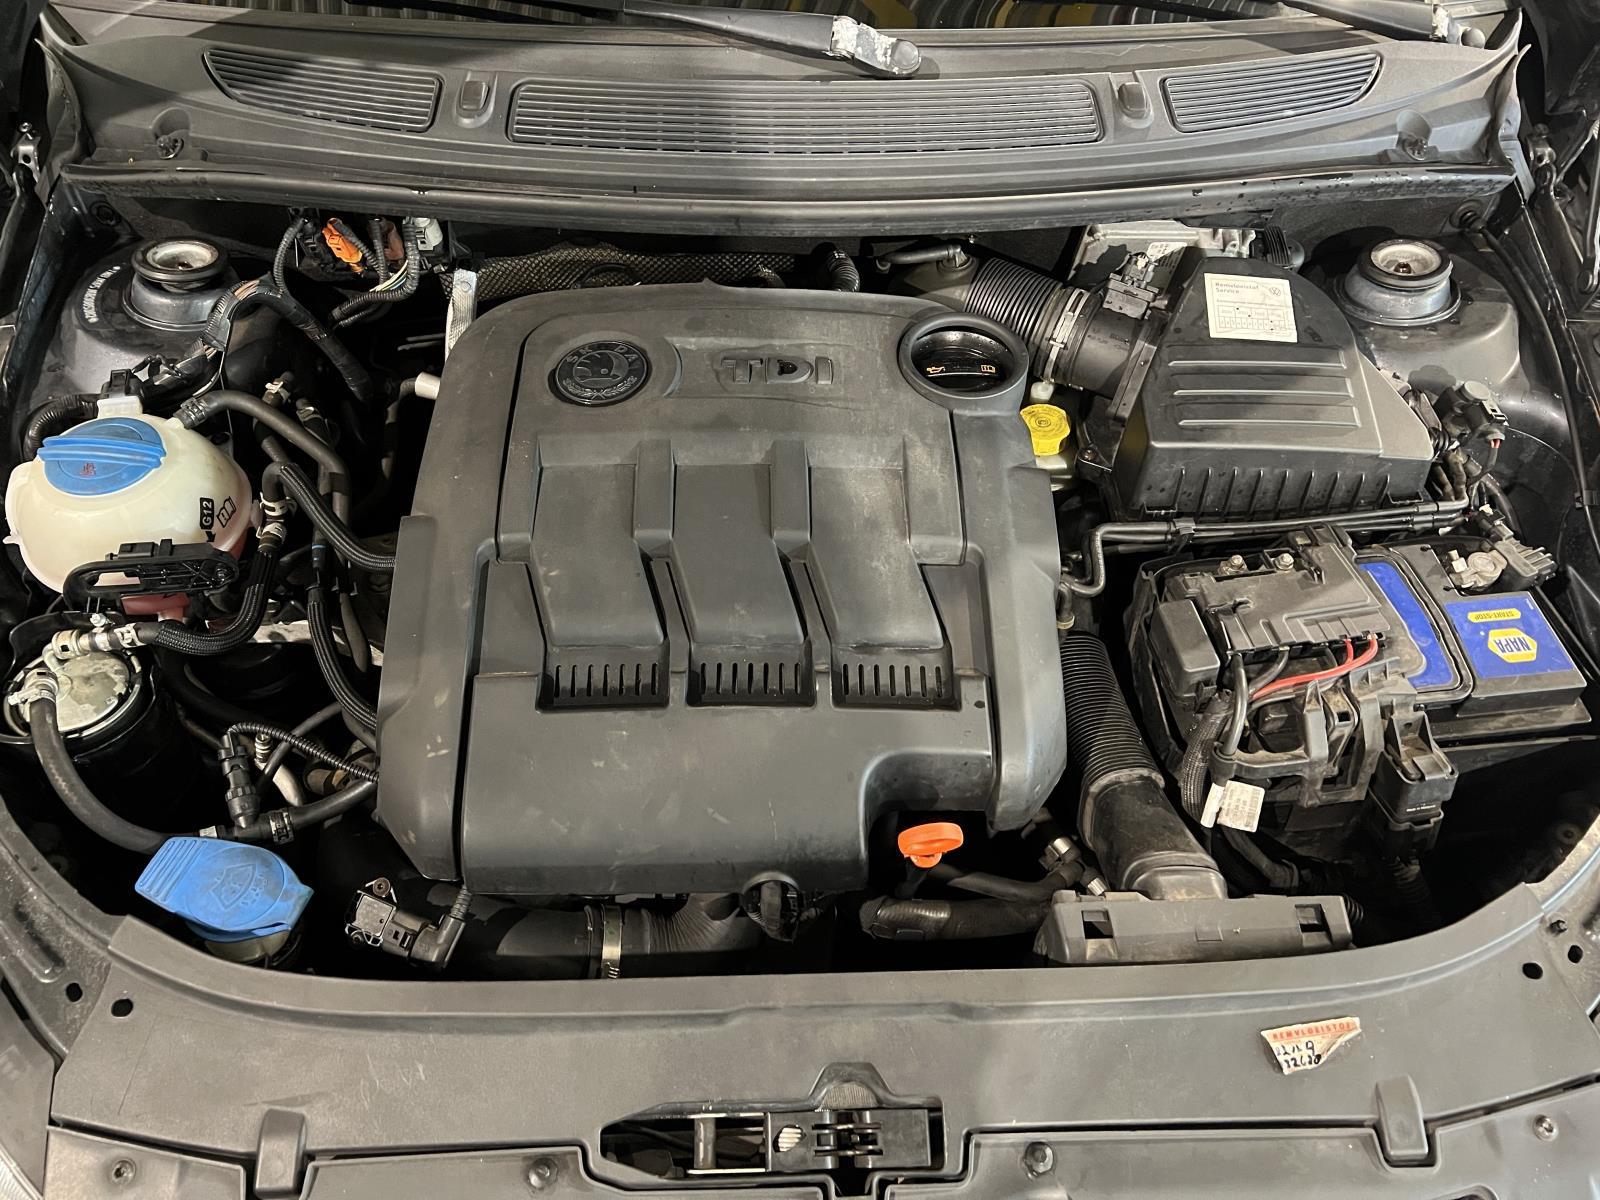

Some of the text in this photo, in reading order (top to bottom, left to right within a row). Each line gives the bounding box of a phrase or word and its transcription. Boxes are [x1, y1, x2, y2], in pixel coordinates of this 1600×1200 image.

[720, 356, 834, 385] TDI
[202, 500, 213, 526] G12
[1493, 636, 1532, 653] NAPA
